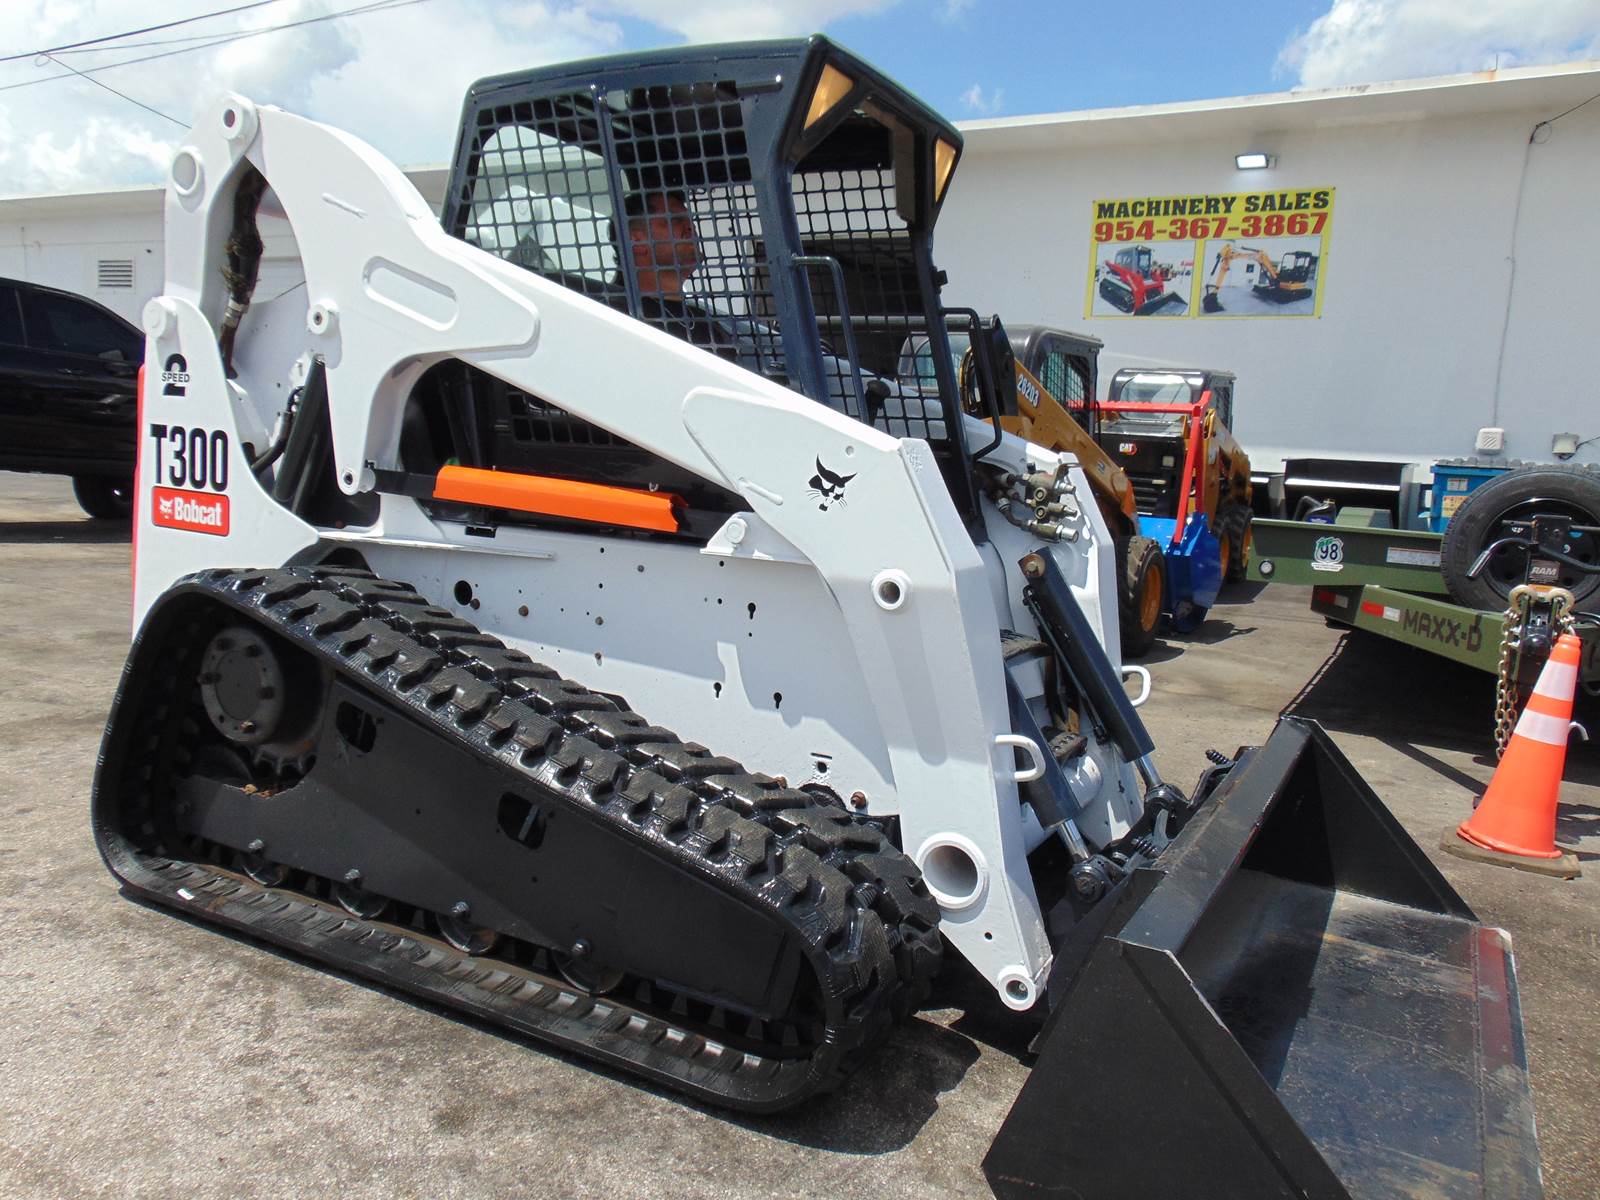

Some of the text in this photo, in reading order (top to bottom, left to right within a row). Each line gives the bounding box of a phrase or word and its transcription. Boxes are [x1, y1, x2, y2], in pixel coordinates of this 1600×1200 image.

[1097, 190, 1330, 219] MACHINERY SALES
[1094, 212, 1329, 242] 954-367-3867
[161, 372, 190, 383] SPEED
[162, 353, 188, 397] 2
[149, 423, 229, 492] T300
[1119, 442, 1134, 453] CAT
[174, 497, 222, 527] Bobcat
[1530, 566, 1557, 576] RAM
[1403, 608, 1483, 652] MAXX-D
